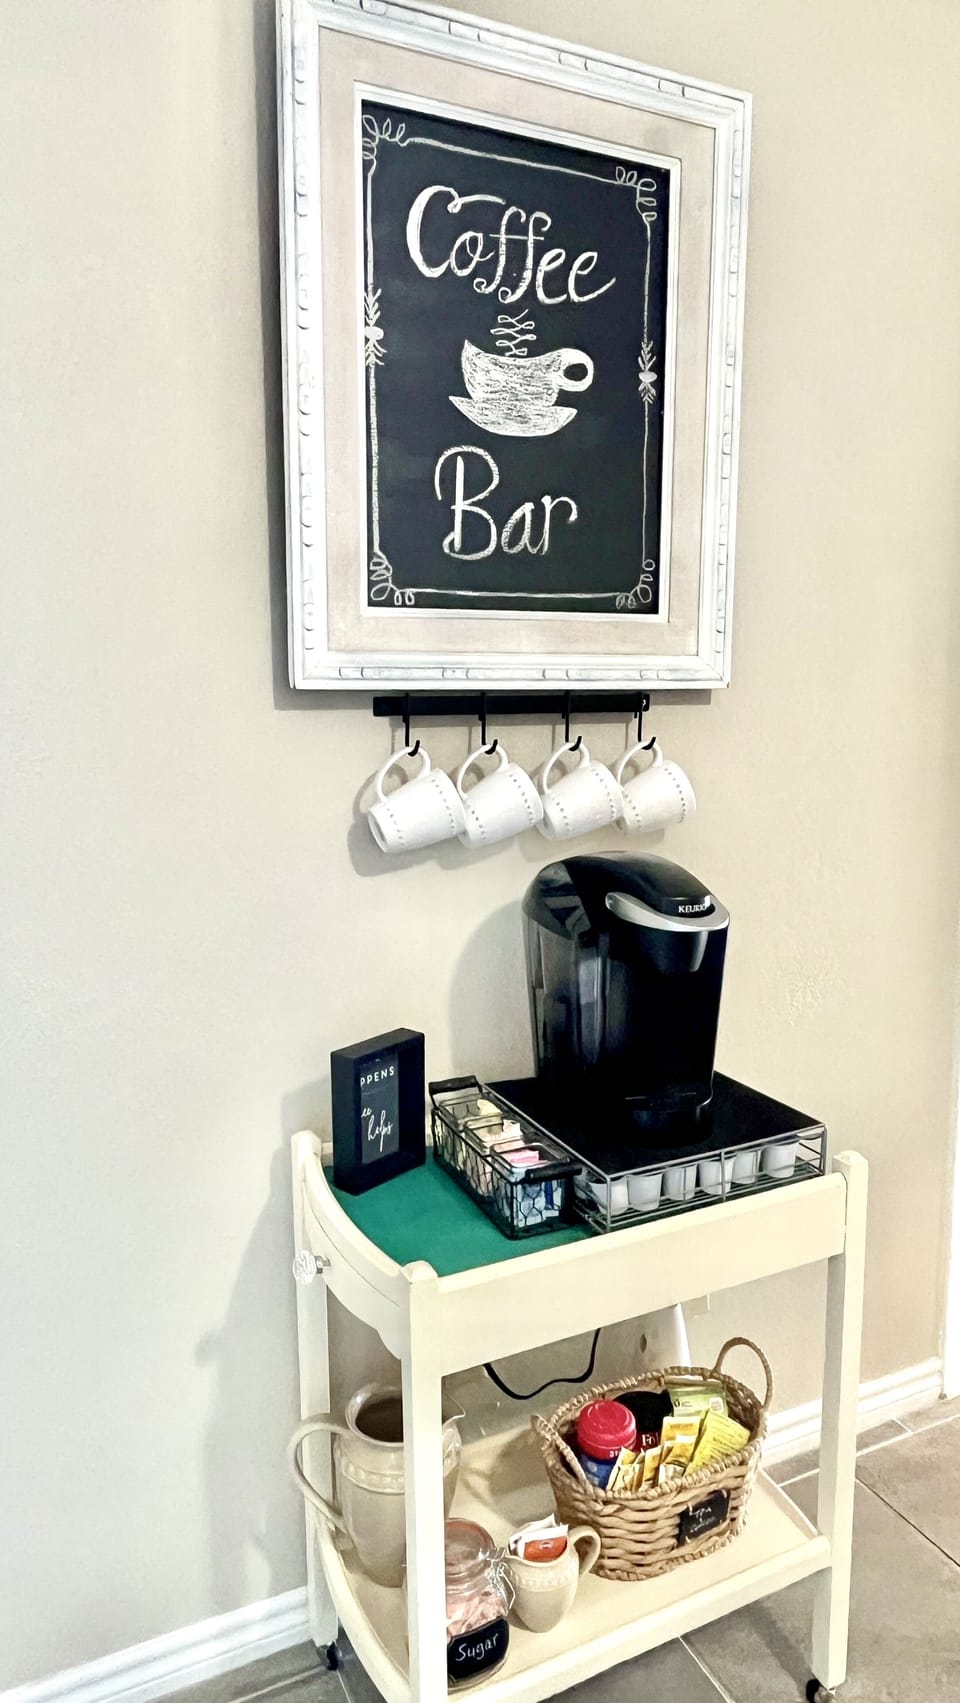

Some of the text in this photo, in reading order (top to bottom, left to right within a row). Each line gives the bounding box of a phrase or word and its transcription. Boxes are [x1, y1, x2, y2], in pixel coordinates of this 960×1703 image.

[406, 184, 616, 304] Coffee
[434, 444, 578, 561] Bar
[455, 1633, 499, 1661] Sugar
